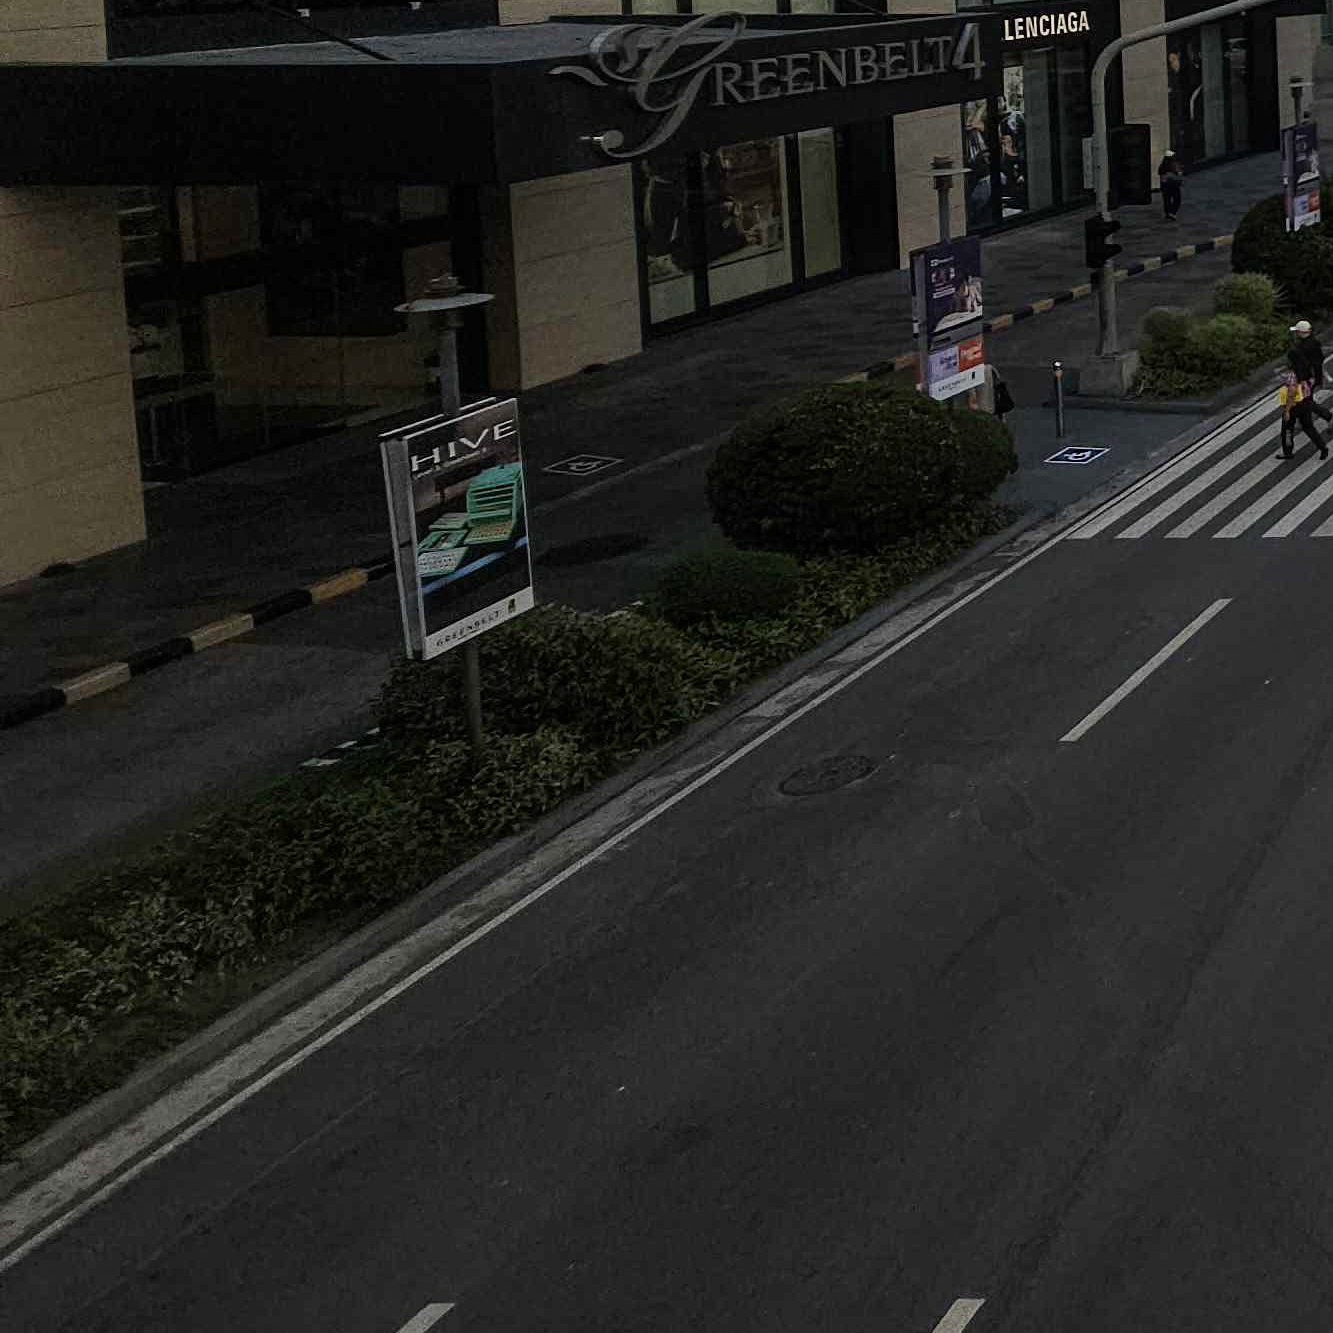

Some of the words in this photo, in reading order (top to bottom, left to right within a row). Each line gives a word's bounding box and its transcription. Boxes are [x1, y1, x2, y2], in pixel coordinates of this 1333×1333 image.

[1001, 10, 1090, 41] LENCIAGA
[549, 11, 953, 158] GREENBELT
[411, 419, 518, 472] HIVE
